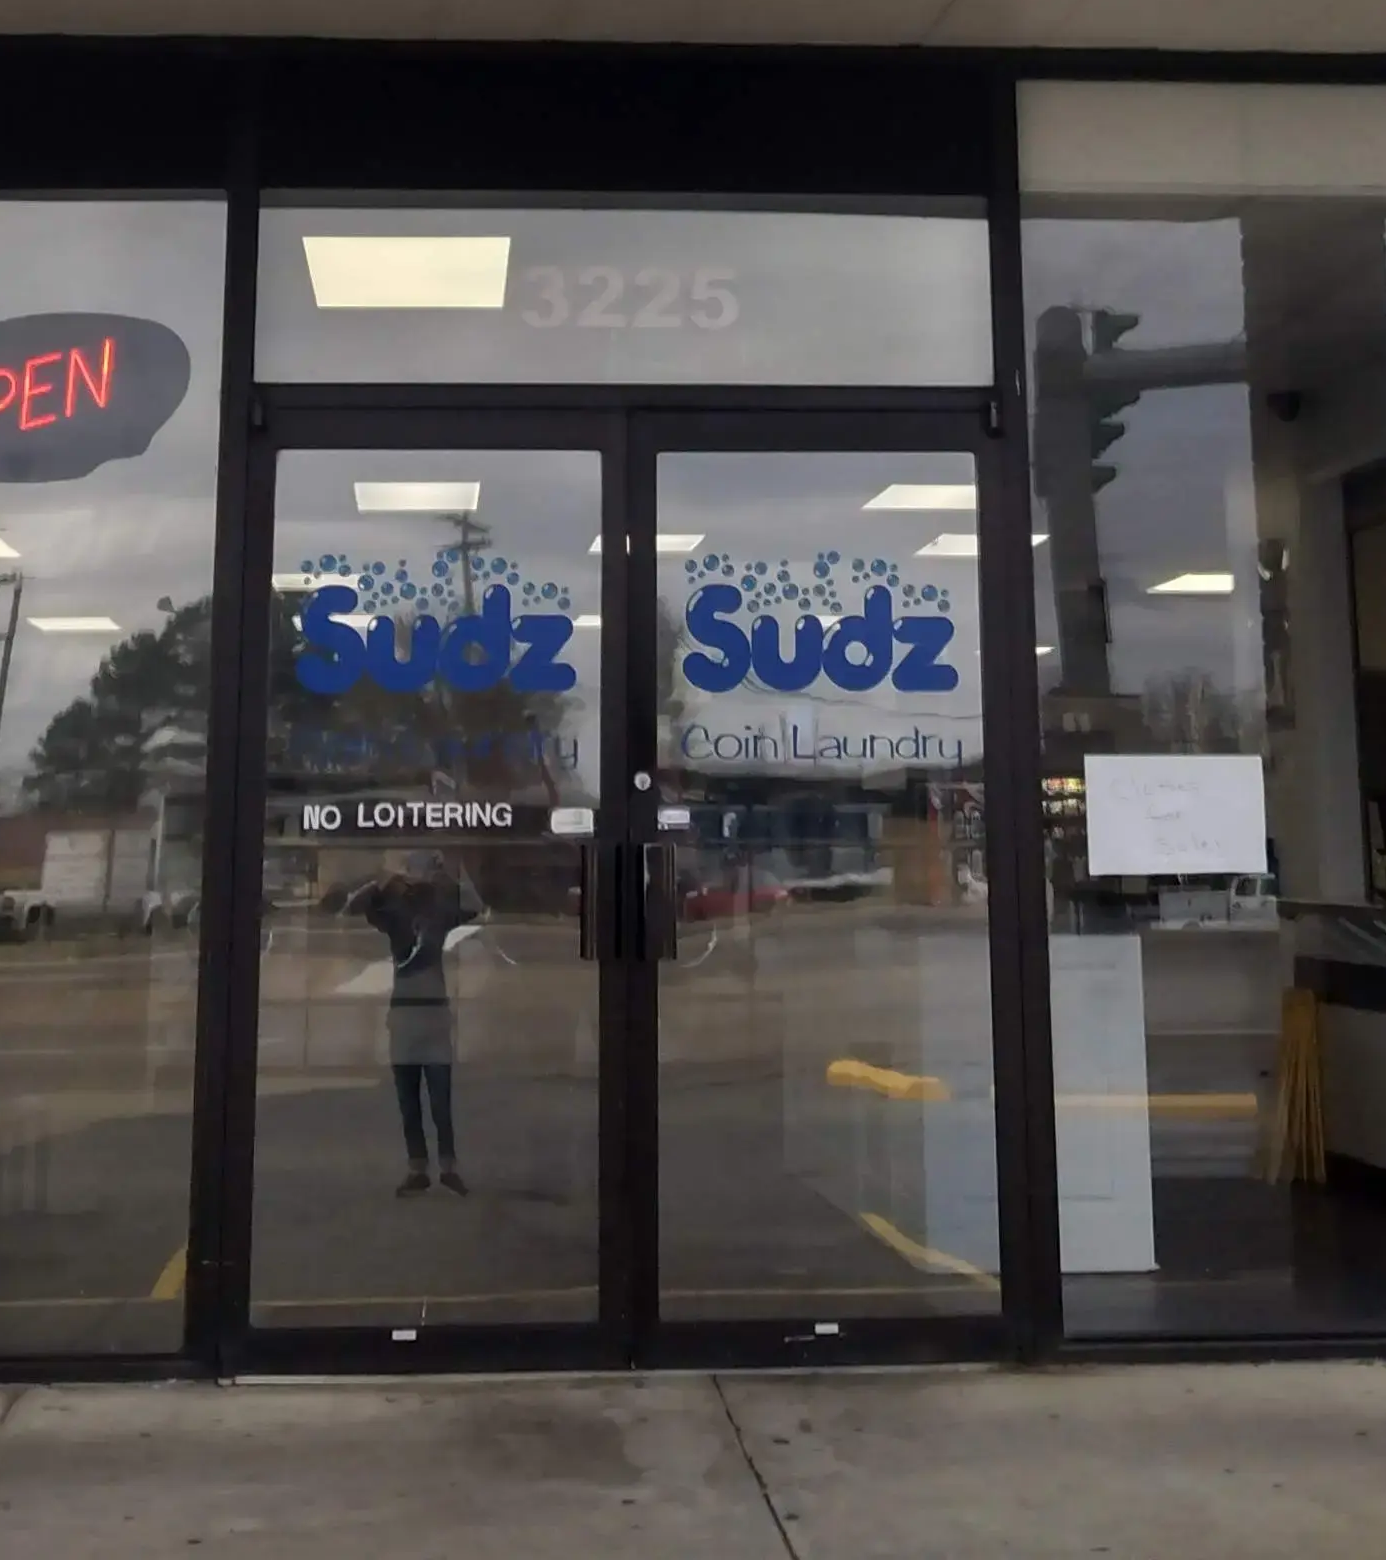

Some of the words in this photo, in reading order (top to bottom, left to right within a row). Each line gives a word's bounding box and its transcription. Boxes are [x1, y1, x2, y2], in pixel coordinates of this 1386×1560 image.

[523, 265, 739, 330] 3225
[294, 583, 577, 695] Sudz
[682, 584, 958, 693] Sudz
[681, 723, 780, 760] Coin
[792, 722, 963, 768] Laundry
[302, 804, 342, 830] NO
[357, 801, 513, 828] LOITERING
